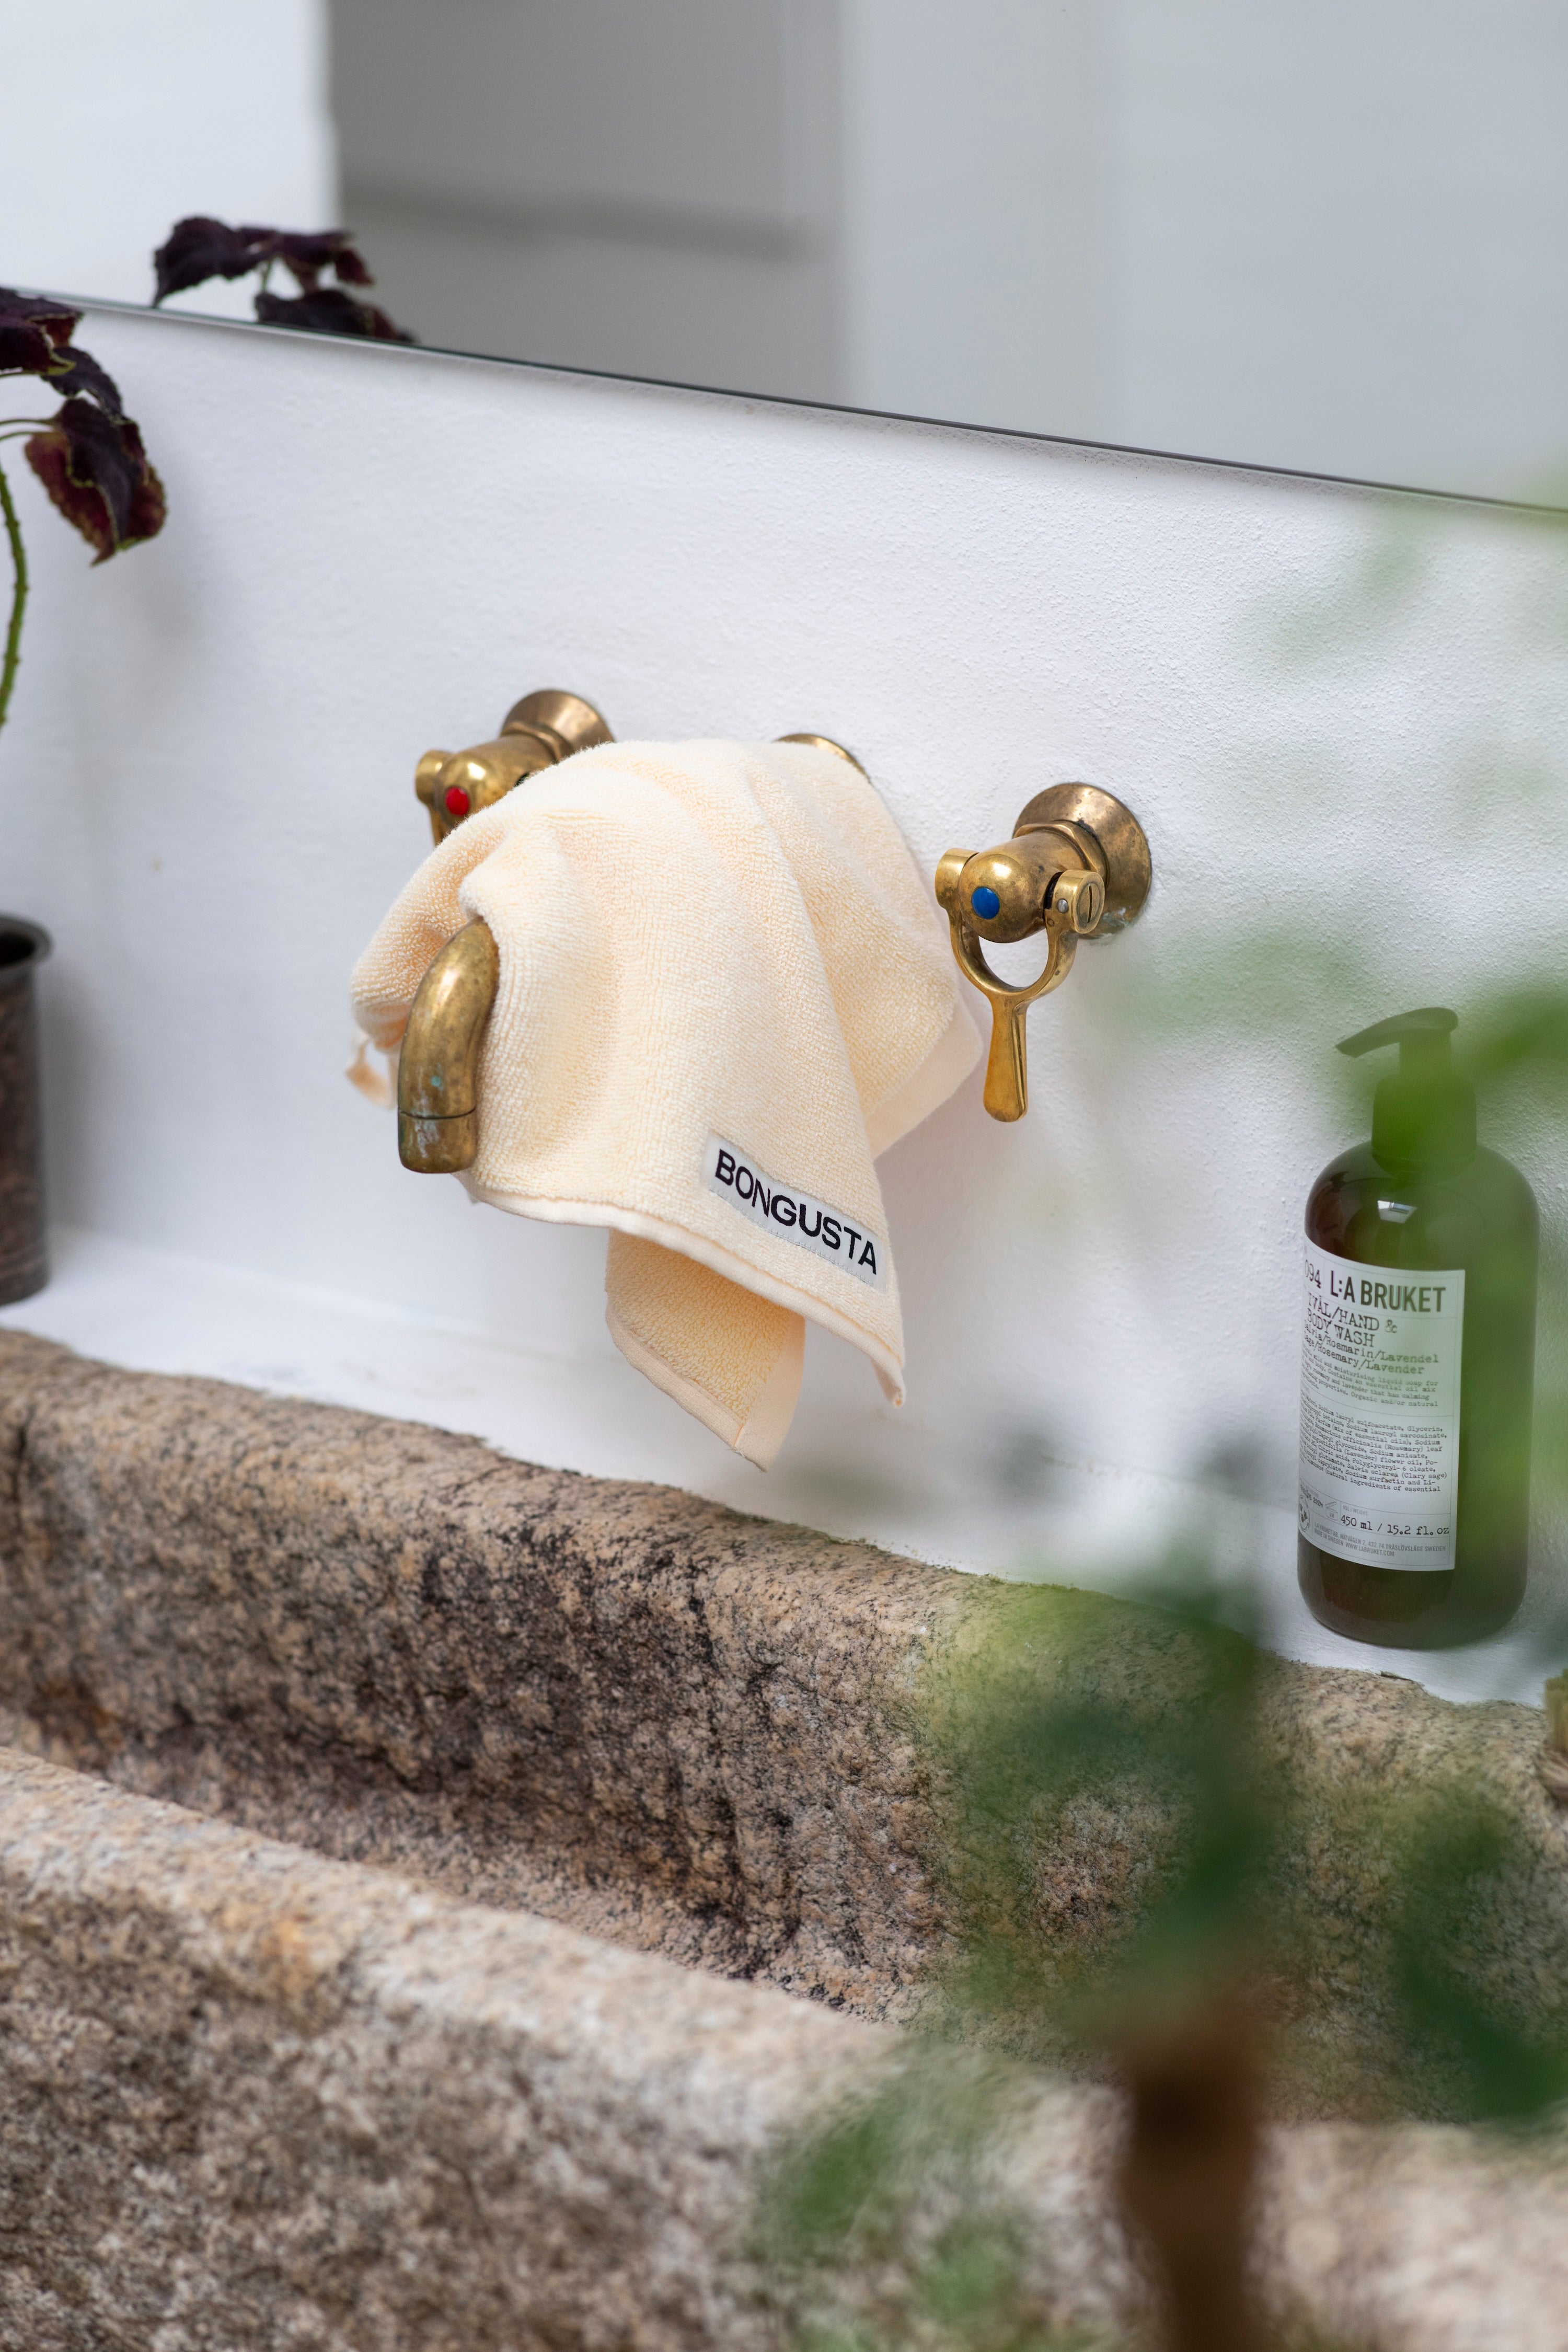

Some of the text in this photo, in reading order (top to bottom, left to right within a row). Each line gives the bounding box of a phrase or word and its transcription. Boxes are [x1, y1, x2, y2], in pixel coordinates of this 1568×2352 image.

[715, 1148, 877, 1275] BONGUSTA
[1330, 1270, 1447, 1313] L:A BRUKET
[1307, 1308, 1375, 1347] BODY WASH
[1385, 1319, 1398, 1333] &
[1328, 1368, 1353, 1382] Contains
[1366, 1382, 1402, 1391] essential
[1342, 1380, 1368, 1393] lavender
[1379, 1377, 1402, 1386] liquid
[1351, 1391, 1378, 1402] Organic
[1346, 1423, 1368, 1433] Sodium
[1355, 1433, 1388, 1443] essential
[1369, 1448, 1394, 1457] Sodium
[1385, 1443, 1424, 1454] (Rosemary)
[1344, 1448, 1377, 1462] (Lavender)
[1380, 1456, 1405, 1465] flower
[1325, 1467, 1348, 1481] (natural
[1350, 1478, 1391, 1490] ingredients
[1345, 1469, 1367, 1480] Sodium
[1369, 1475, 1405, 1485] surfactin
[1347, 1463, 1368, 1473] Salvia
[1371, 1469, 1399, 1478] sclarea
[1428, 1472, 1447, 1480] sage)
[1341, 1515, 1357, 1527] 450
[1360, 1521, 1373, 1531] ml
[1377, 1523, 1383, 1532] /
[1387, 1524, 1411, 1535] 15.2
[1416, 1526, 1434, 1536] fl.
[1328, 1535, 1344, 1546] SWEDEN
